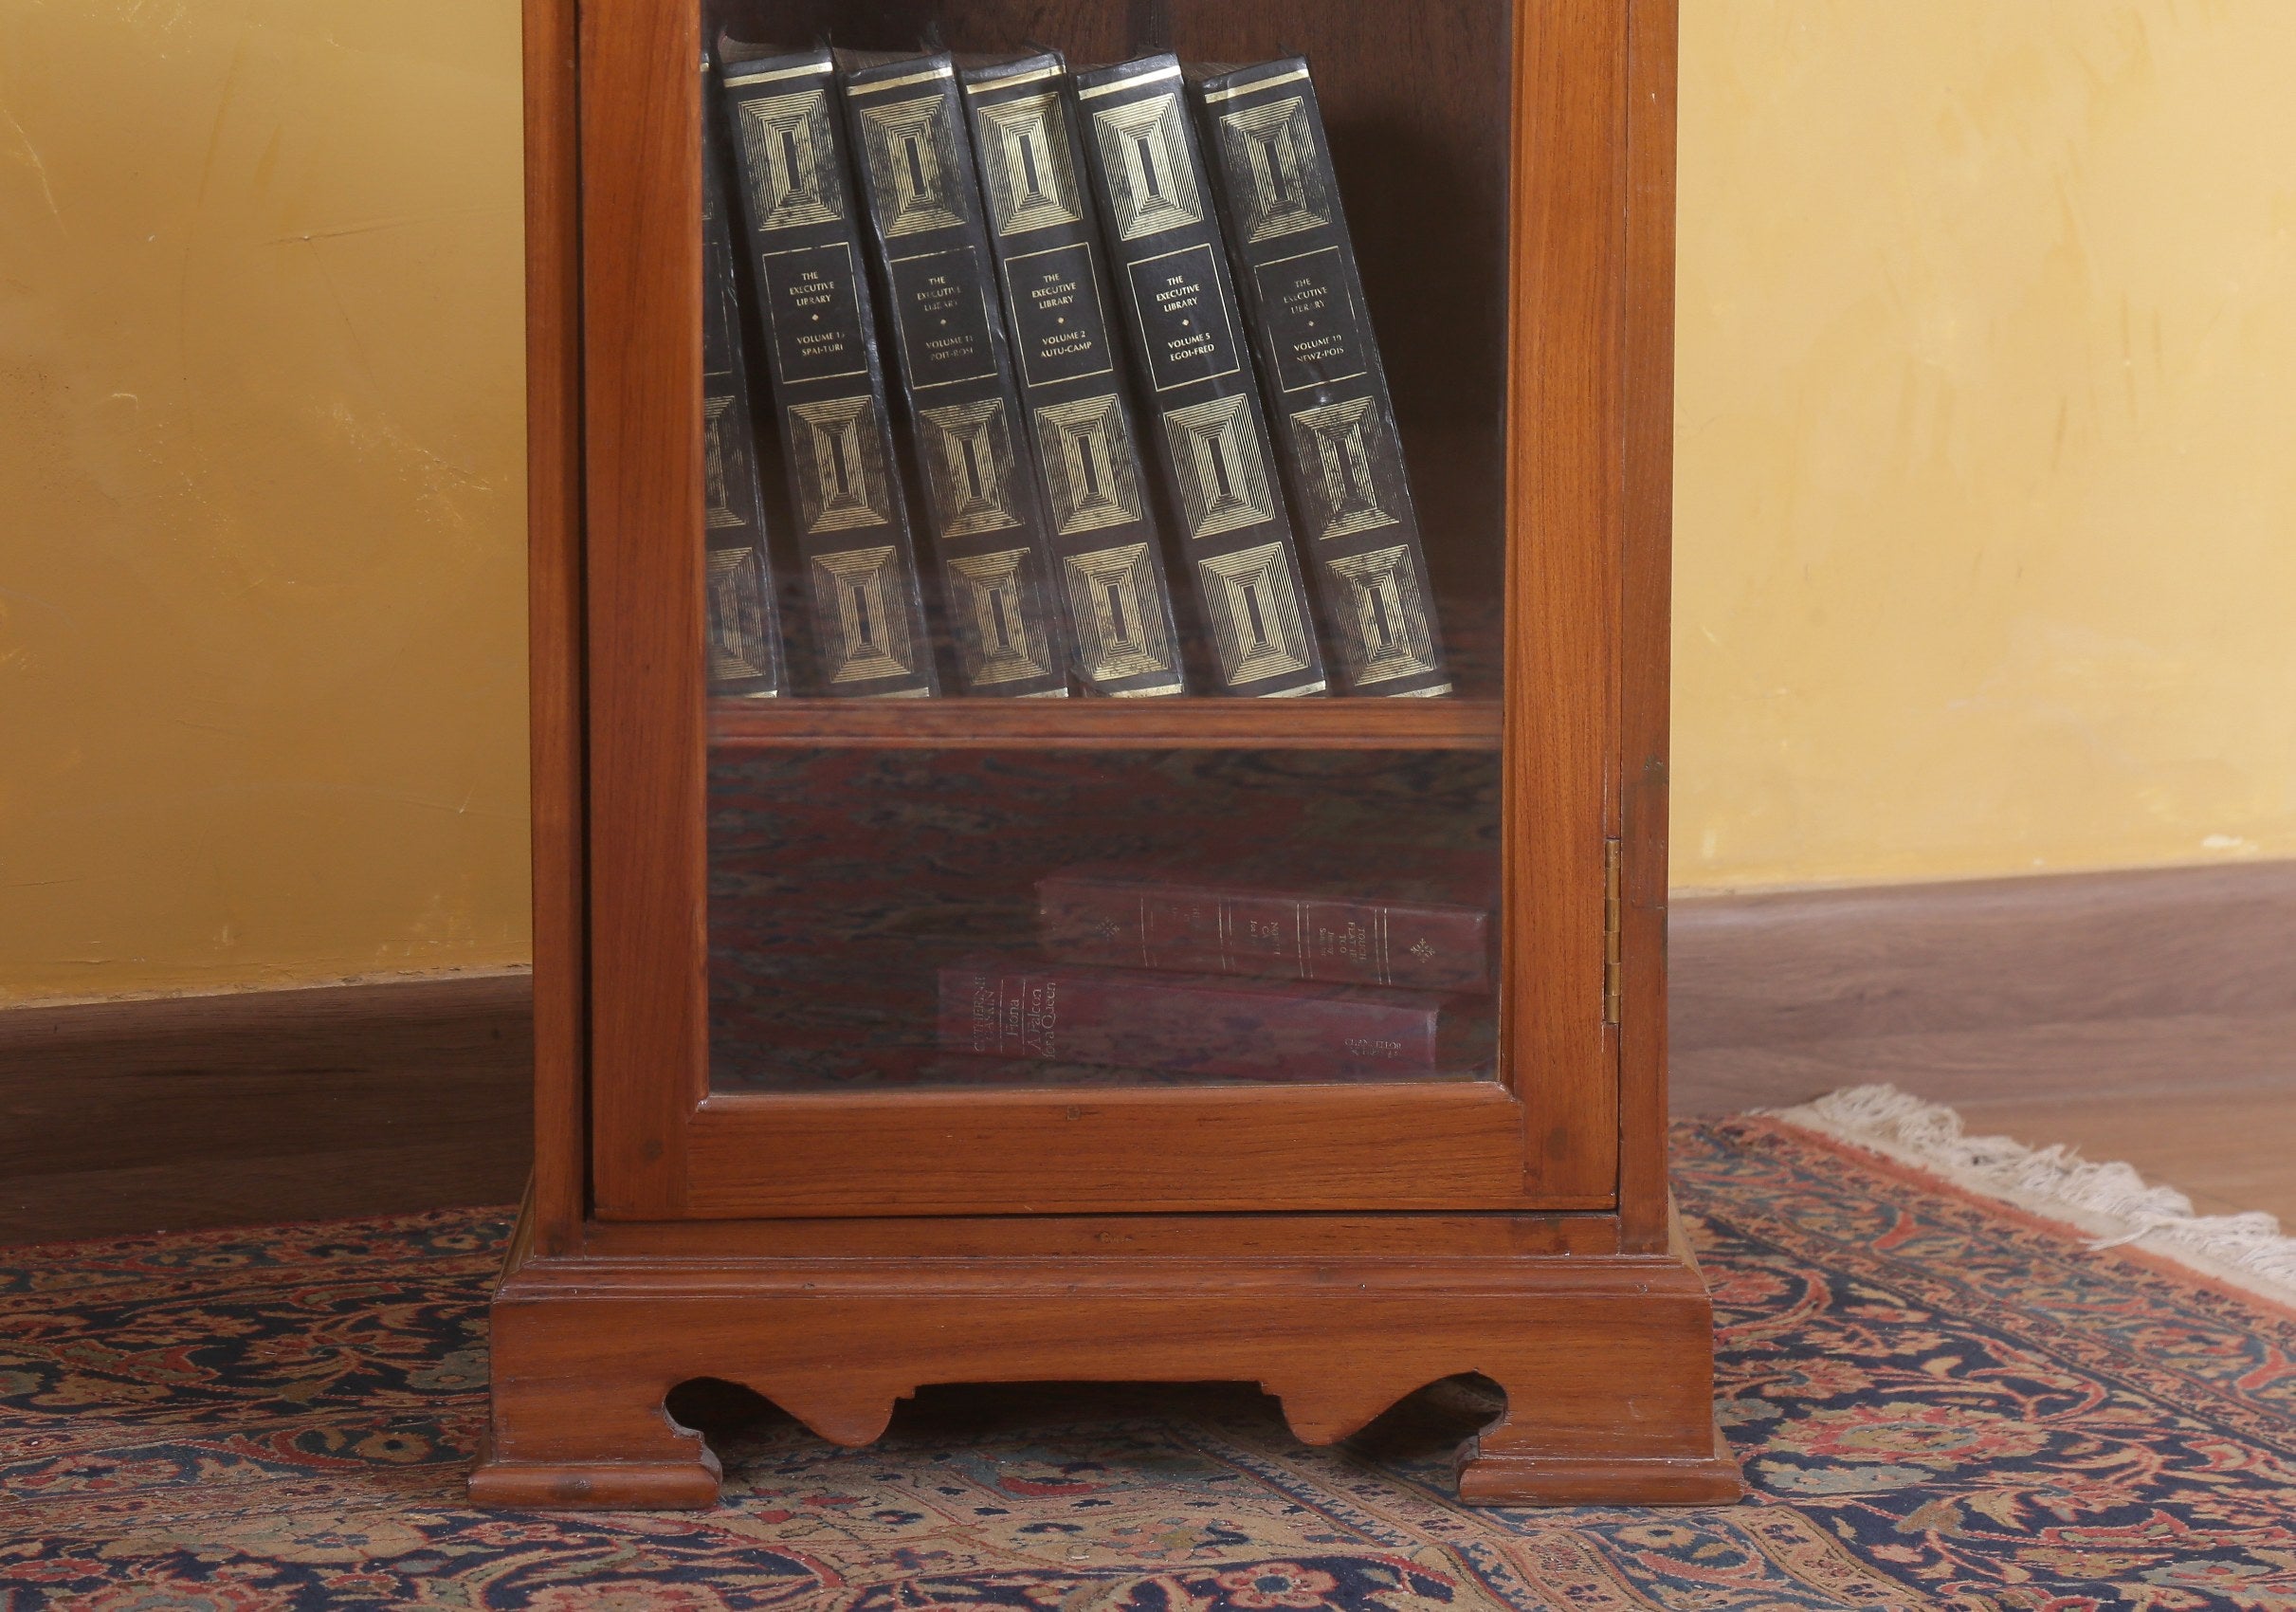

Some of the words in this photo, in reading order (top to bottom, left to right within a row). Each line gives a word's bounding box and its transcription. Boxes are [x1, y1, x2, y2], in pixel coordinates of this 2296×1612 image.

[801, 271, 818, 281] THE
[928, 276, 946, 284] THE
[1043, 273, 1060, 283] THE
[1166, 275, 1184, 286] THE
[789, 282, 834, 295] EXECUTIVE
[1294, 278, 1311, 288] THE
[1031, 282, 1077, 298] EXECUTIVE
[1156, 284, 1200, 302] EXECUTIVE
[796, 295, 831, 306] LIBRARY
[1039, 295, 1074, 309] LIBRARY
[1163, 297, 1197, 312] LIBRARY
[1290, 300, 1325, 314] LIBRRY
[796, 332, 833, 344] VOLUME
[925, 336, 963, 349] VOLUME
[1042, 332, 1079, 345] VOLUME
[1167, 333, 1204, 349] VOLUME
[1293, 337, 1330, 352] VOLUME
[1040, 341, 1092, 357] AUTU-CAMP
[1170, 343, 1214, 361] EGOI-FRED
[1006, 998, 1019, 1036] Fiona
